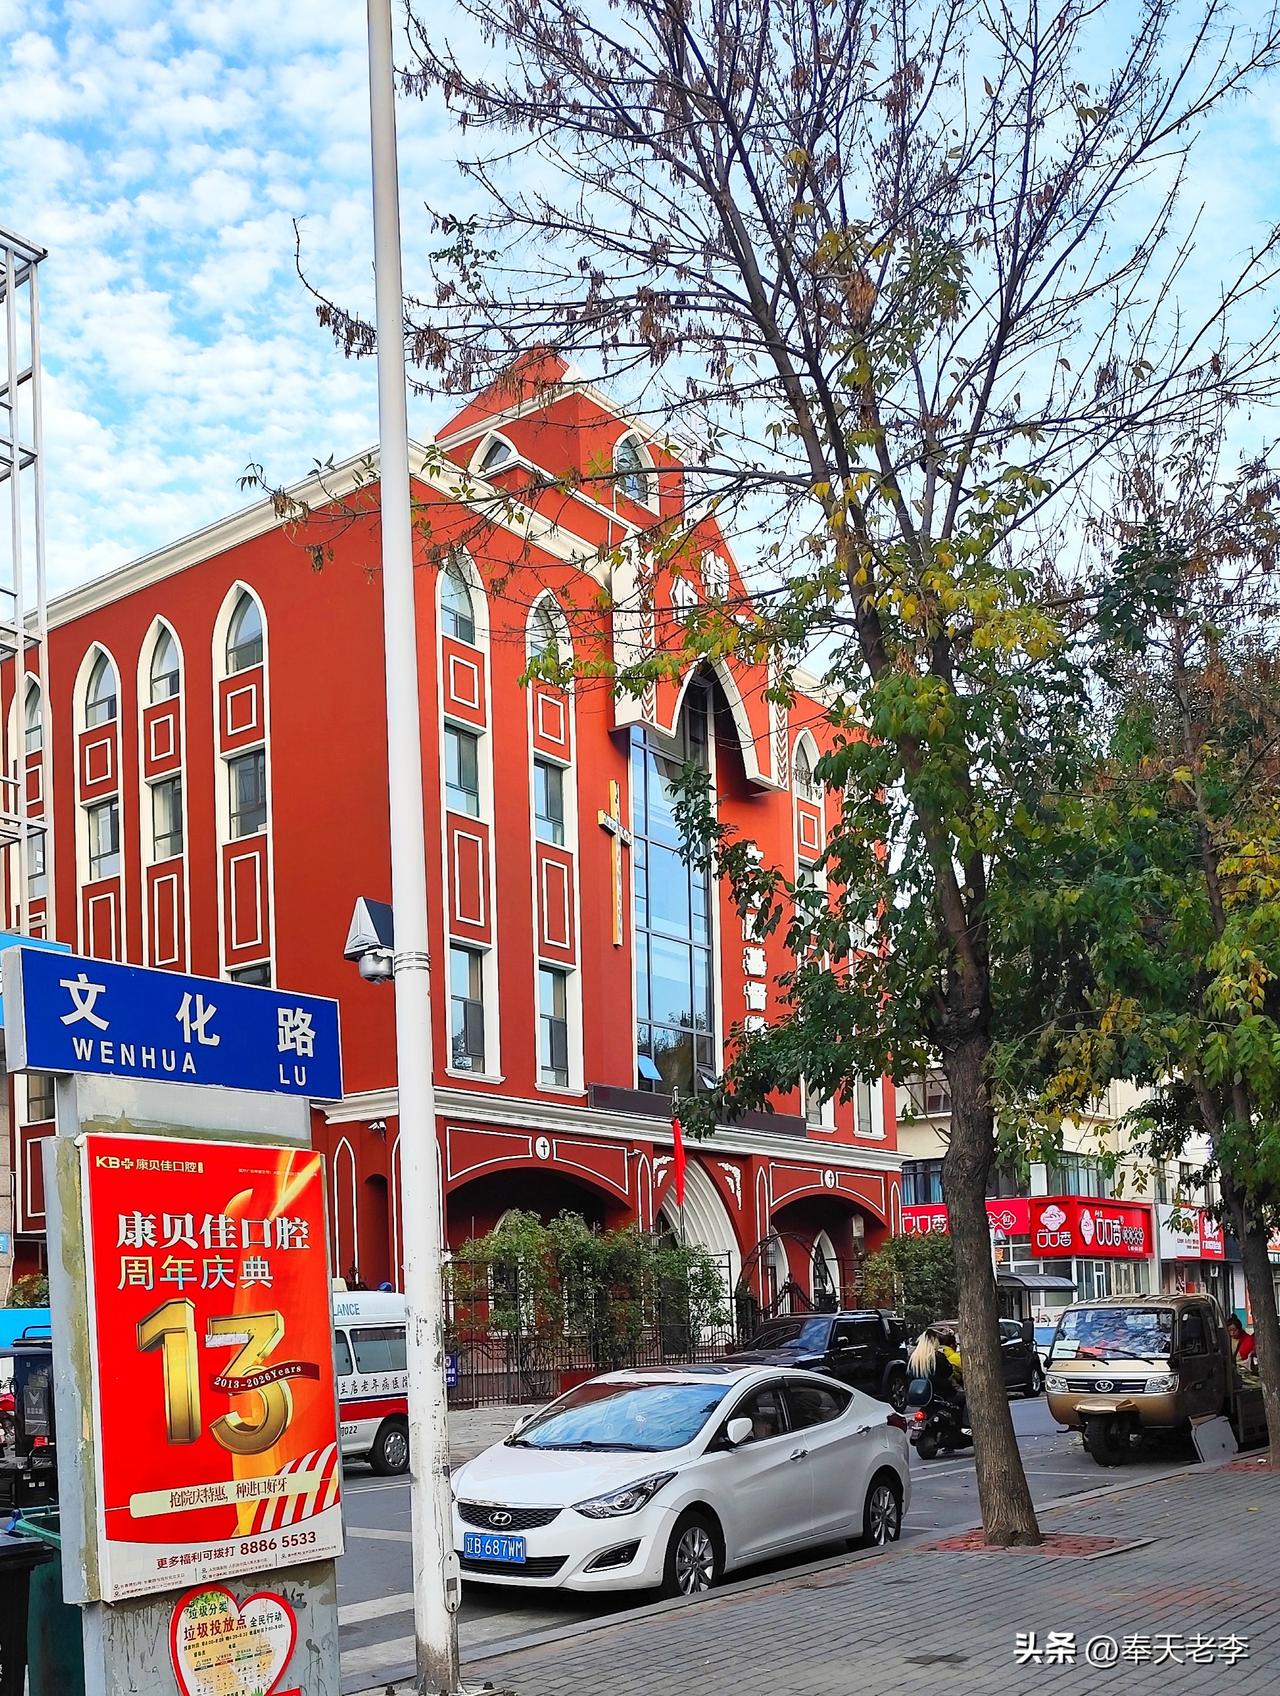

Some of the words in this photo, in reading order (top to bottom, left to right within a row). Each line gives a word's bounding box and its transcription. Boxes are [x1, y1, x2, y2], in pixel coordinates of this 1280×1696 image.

[59, 973, 316, 1058] 文化路
[72, 1037, 196, 1074] WENHUA
[279, 1064, 306, 1086] LU
[95, 1155, 121, 1169] KB
[135, 1157, 197, 1173] 康贝佳口腔
[116, 1210, 310, 1250] 康贝佳口腔
[117, 1254, 274, 1290] 周年庆典
[333, 1303, 360, 1316] ANCE
[136, 1297, 293, 1456] 13
[156, 1546, 236, 1570] 更多福利可拨打
[240, 1538, 277, 1555] 8886
[281, 1531, 316, 1548] 5533
[184, 1614, 247, 1642] 垃圾投放点
[250, 1611, 282, 1628] 全民行动
[188, 1601, 228, 1620] 垃圾分类
